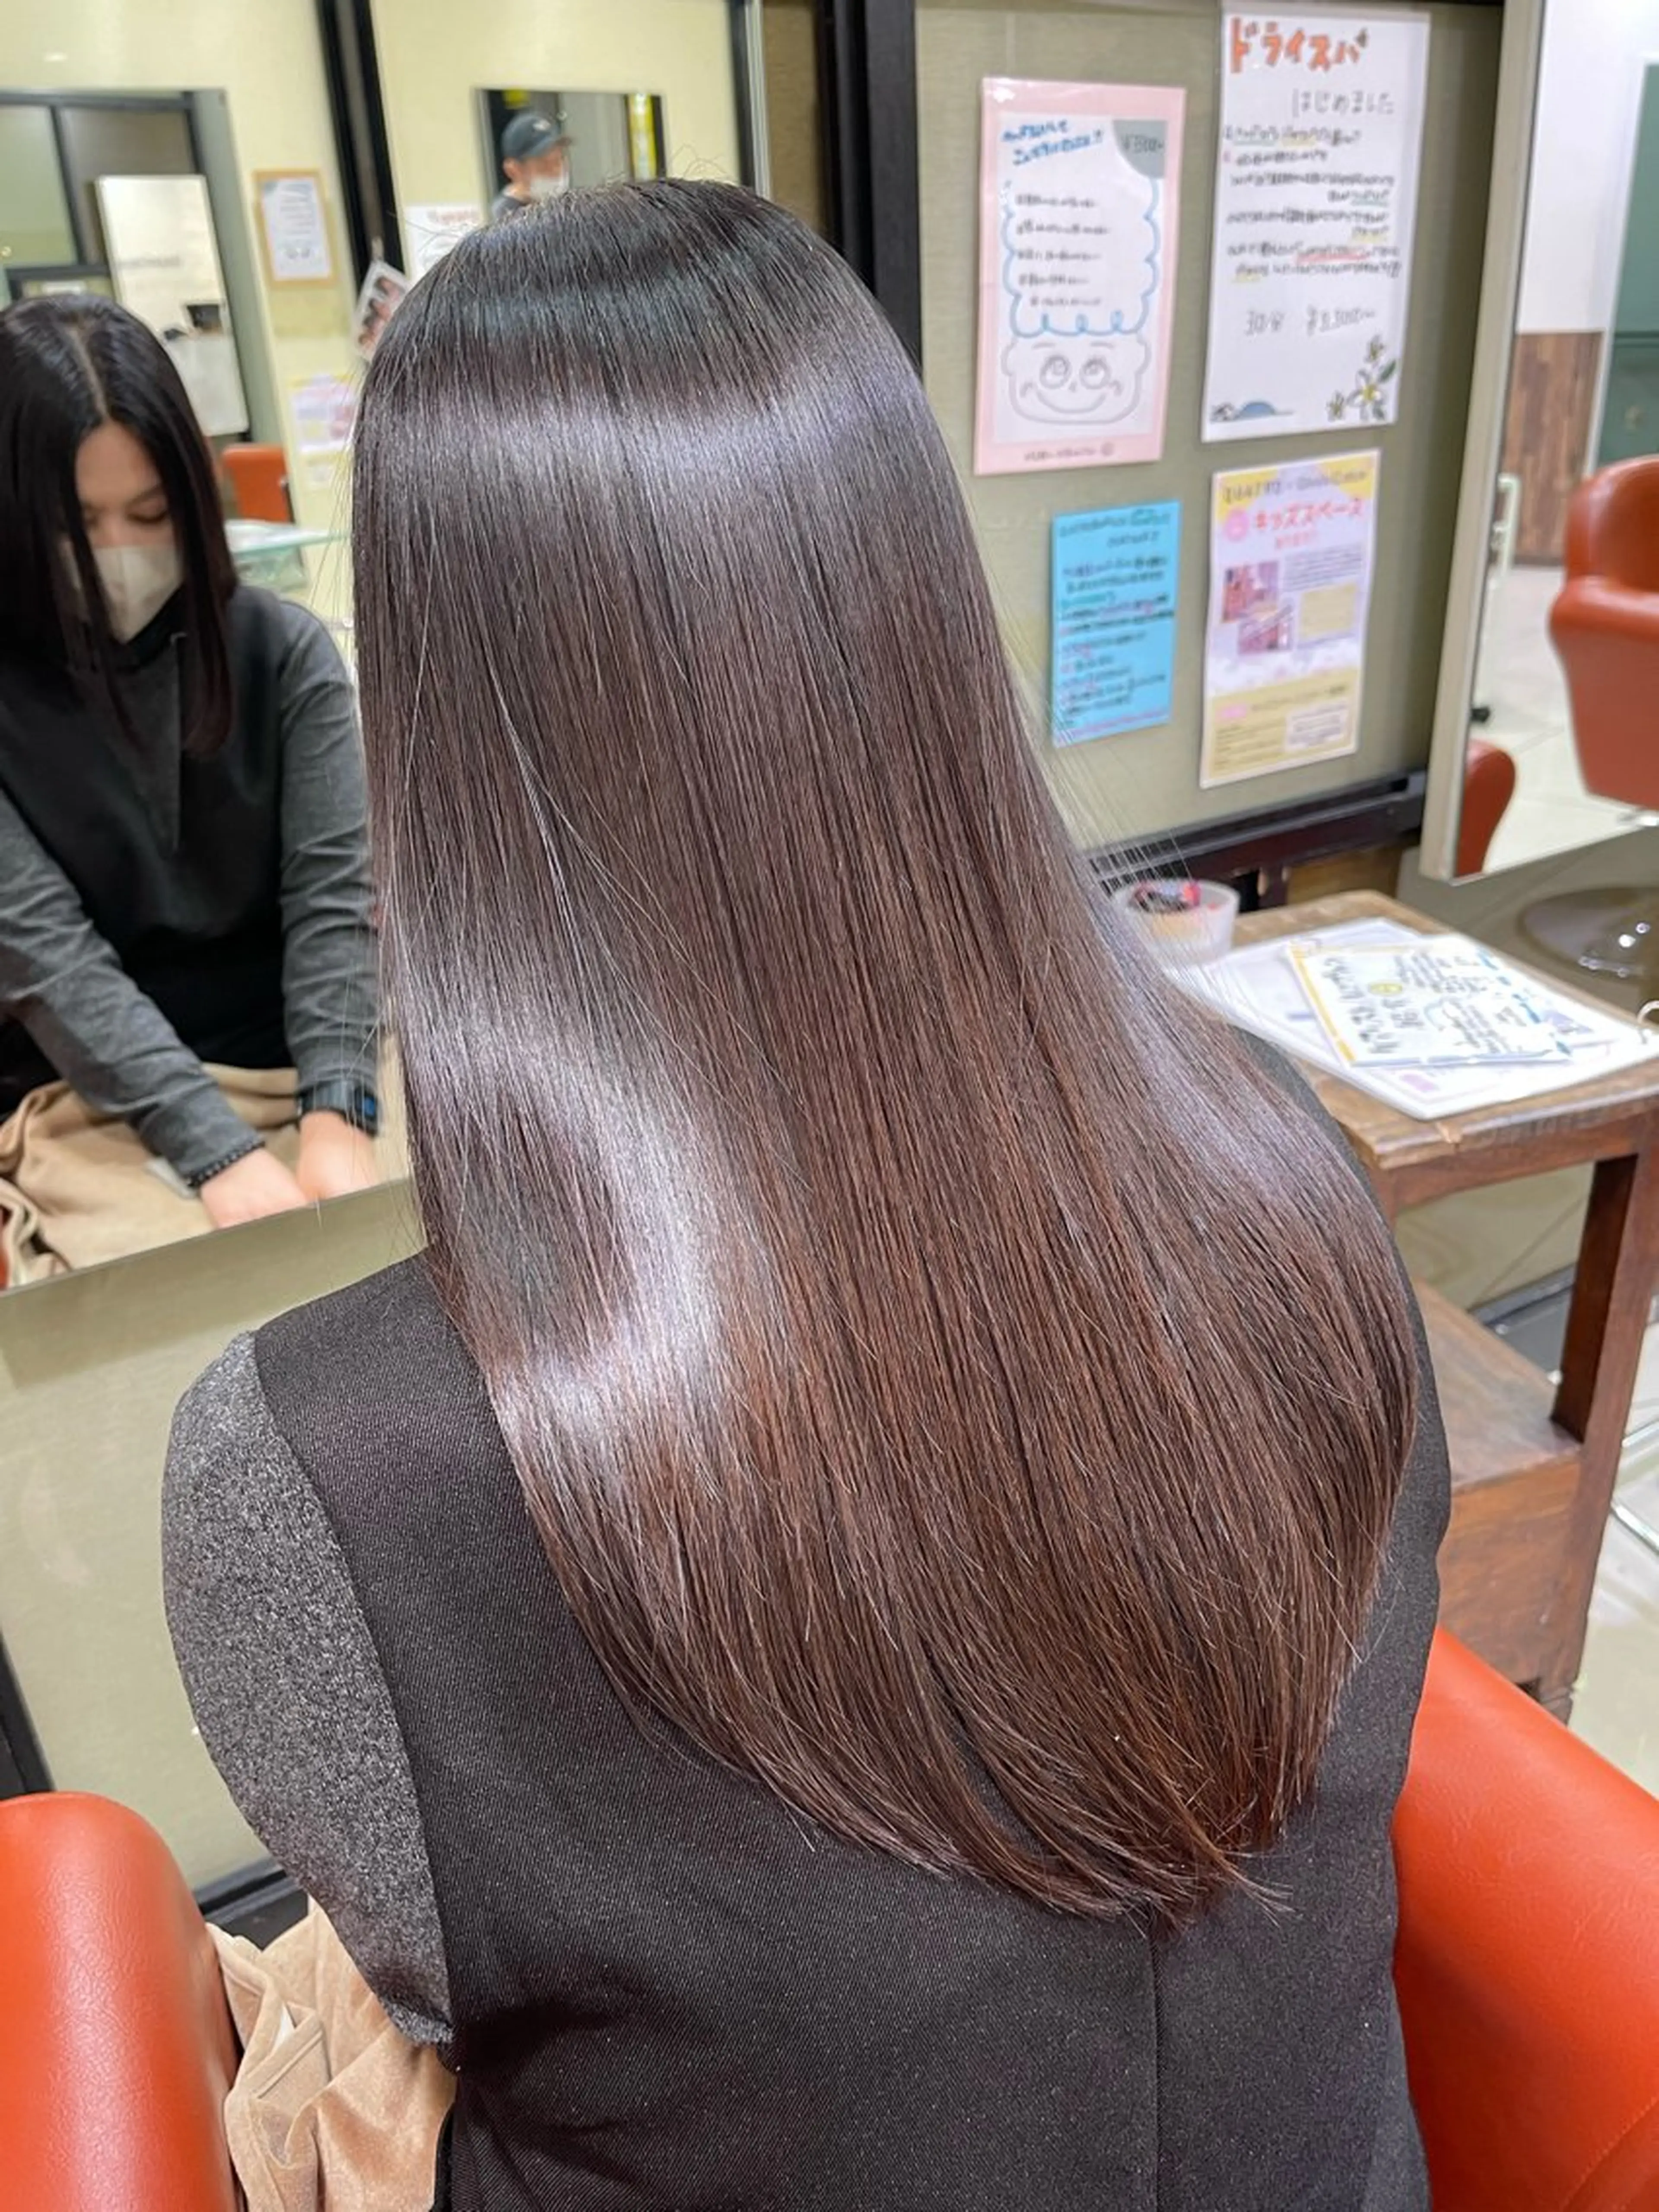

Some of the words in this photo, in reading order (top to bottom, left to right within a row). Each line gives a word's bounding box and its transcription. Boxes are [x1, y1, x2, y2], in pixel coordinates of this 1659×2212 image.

[1230, 16, 1369, 74] ドライスパ
[1292, 88, 1395, 118] はじめました
